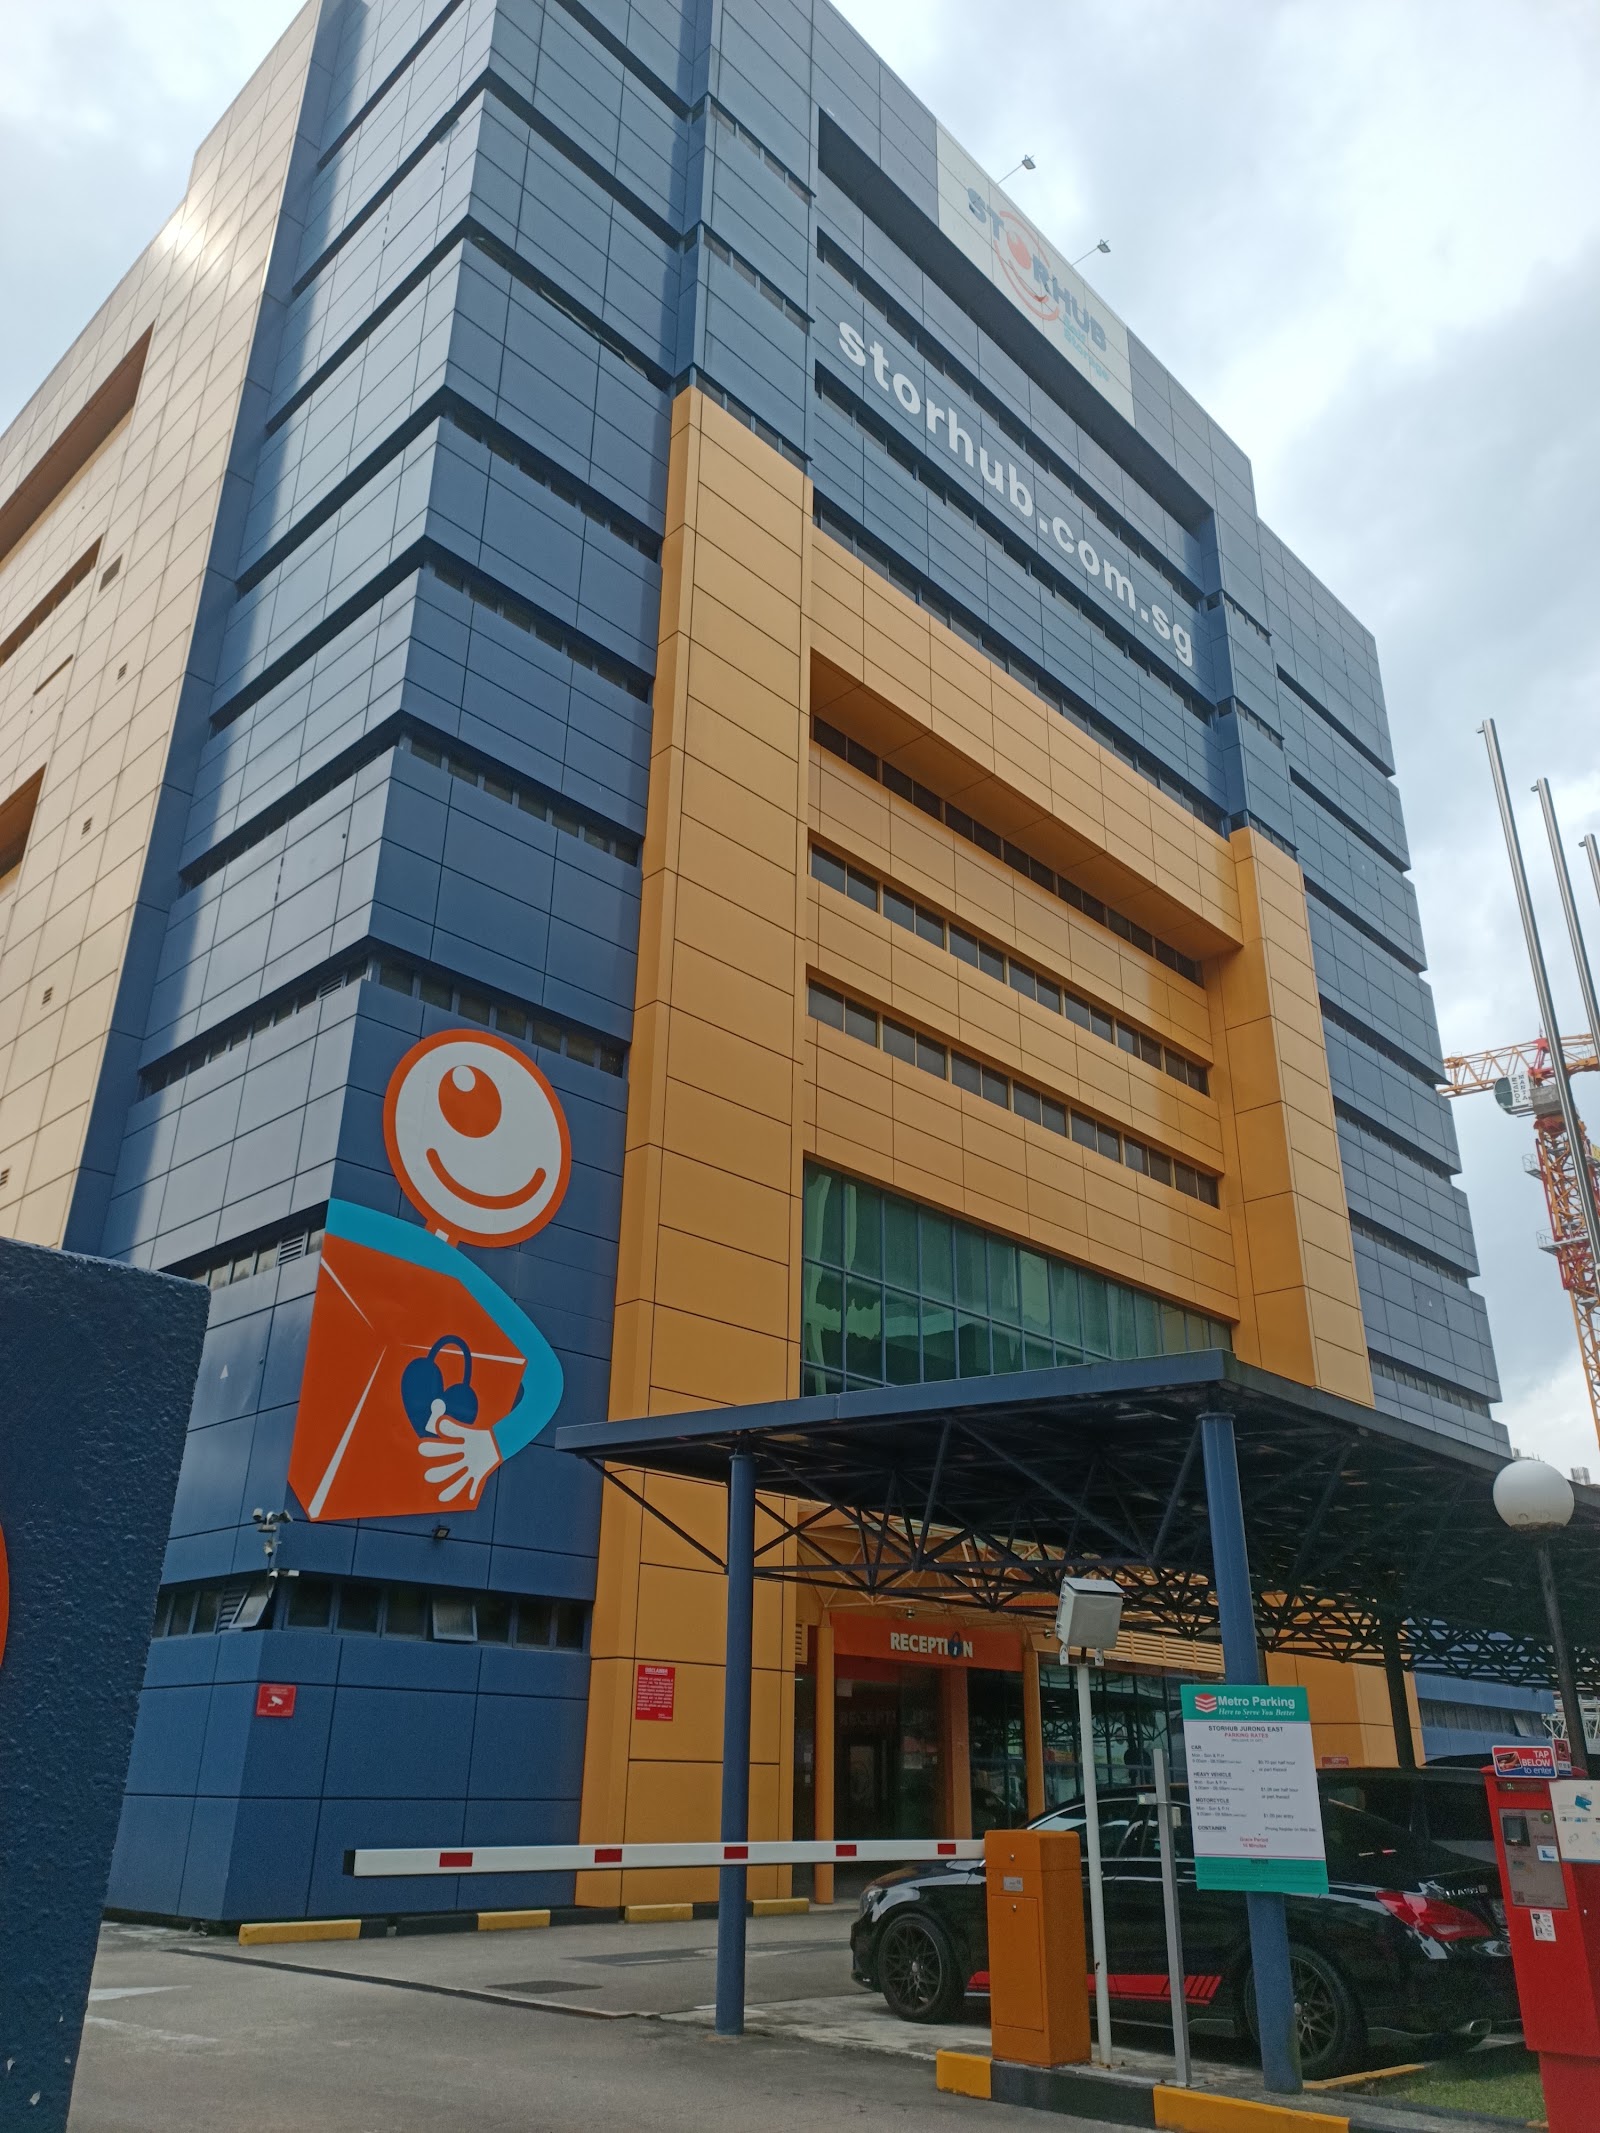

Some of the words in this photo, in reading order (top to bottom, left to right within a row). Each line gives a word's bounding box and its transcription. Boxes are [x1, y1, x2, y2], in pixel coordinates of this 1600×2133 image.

[838, 321, 1194, 667] storhub.com.sg
[1217, 1695, 1250, 1707] Metro
[1252, 1696, 1296, 1709] Parking
[1218, 1708, 1234, 1716] Here
[1243, 1708, 1260, 1716] Serve
[1275, 1709, 1296, 1717] Better
[1532, 1750, 1550, 1759] TAP
[1521, 1758, 1551, 1767] BELOW
[1533, 1767, 1553, 1775] enter
